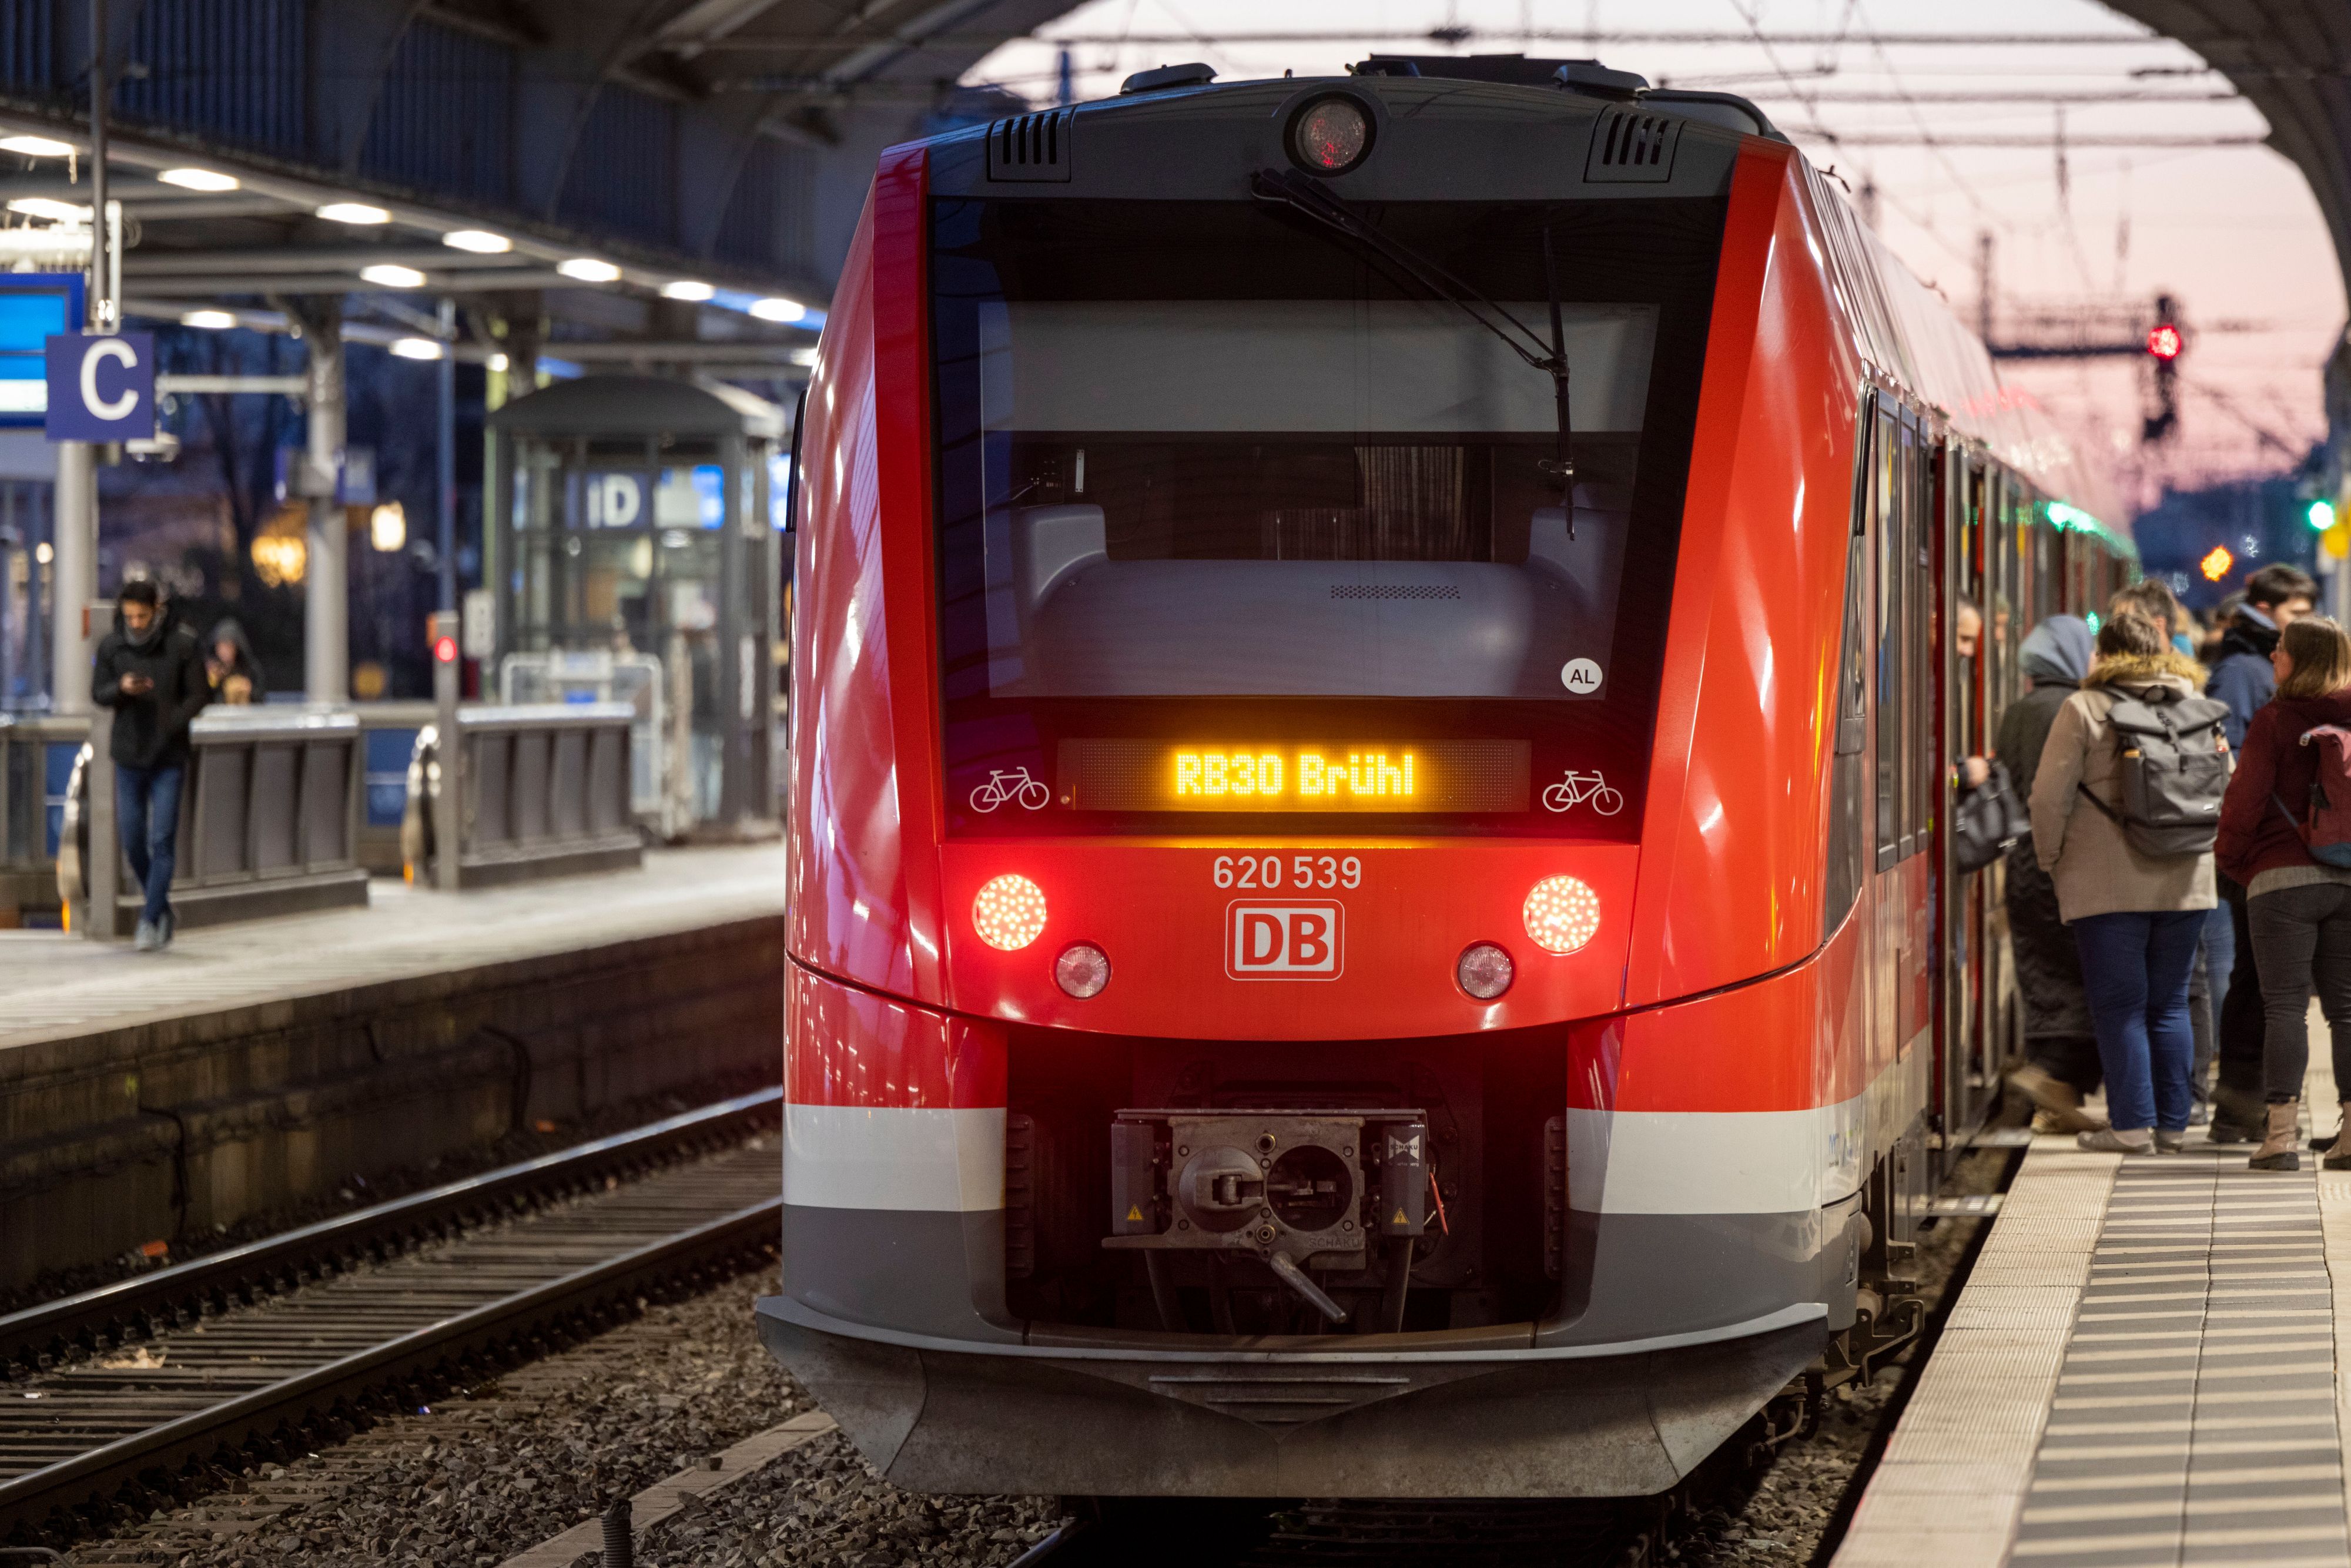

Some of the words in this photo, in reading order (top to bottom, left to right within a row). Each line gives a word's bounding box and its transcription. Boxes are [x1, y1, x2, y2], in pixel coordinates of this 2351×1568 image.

[81, 338, 139, 421] C
[1570, 669, 1595, 685] AL
[1175, 753, 1284, 796] RB30
[1298, 753, 1415, 796] Brühl
[1213, 856, 1282, 889] 620
[1293, 856, 1362, 890] 539
[1241, 913, 1329, 967] DB
